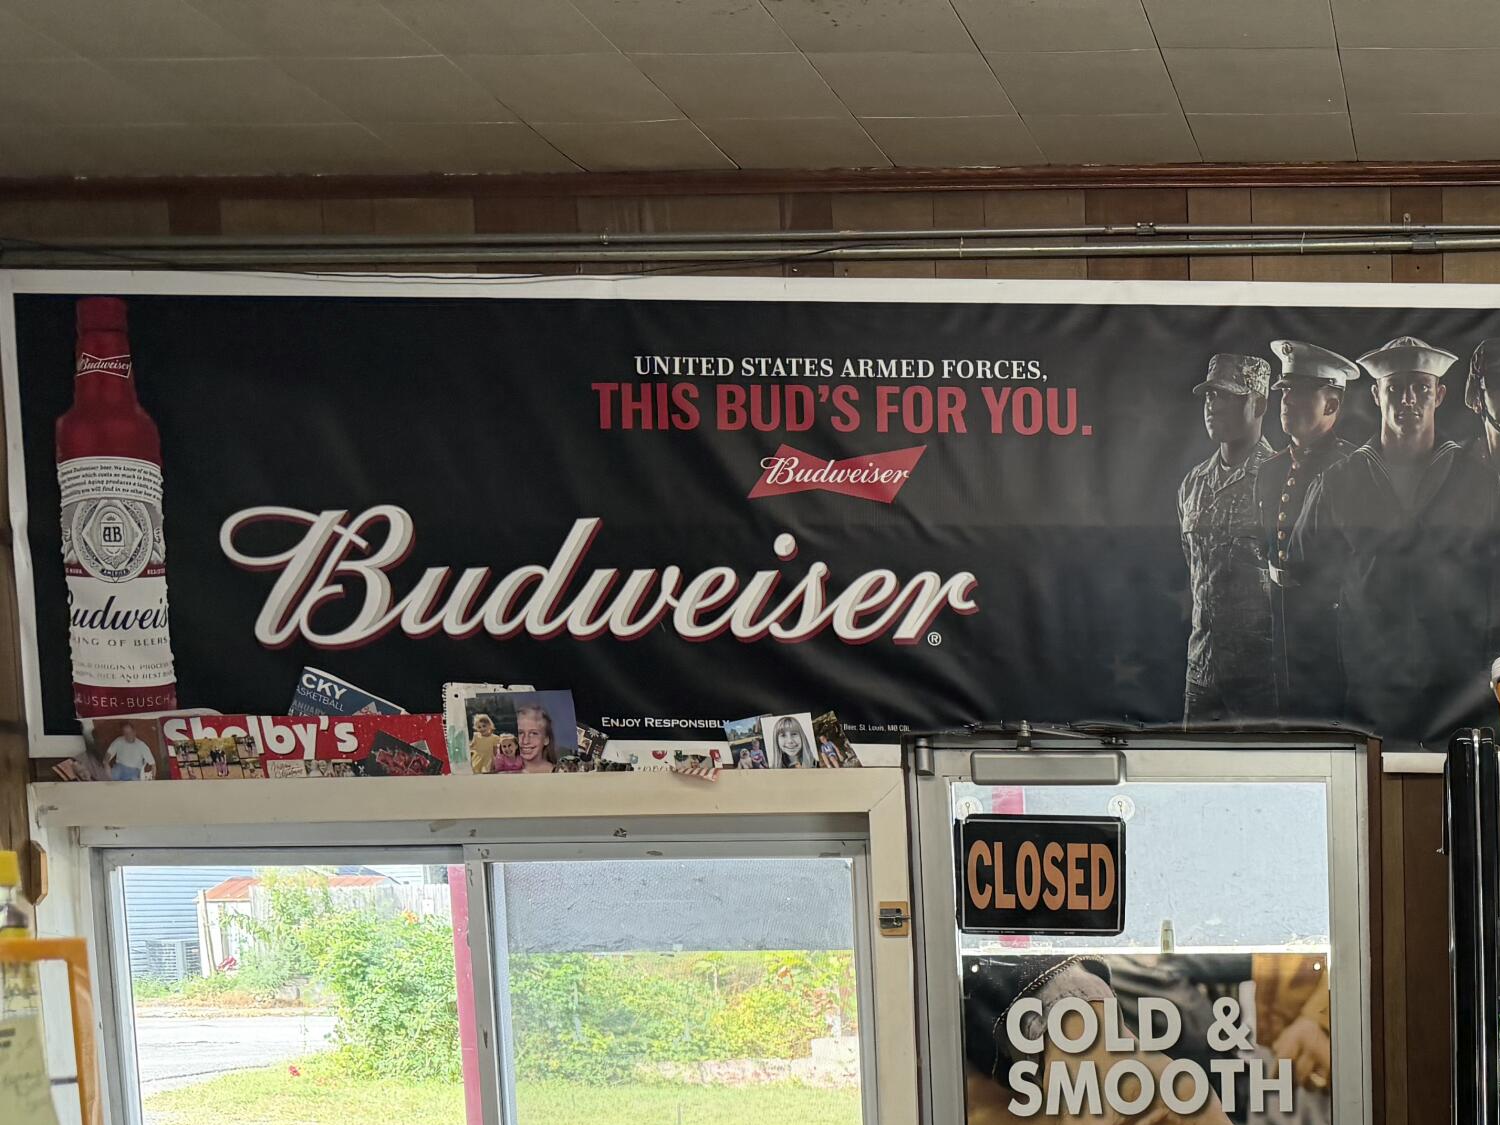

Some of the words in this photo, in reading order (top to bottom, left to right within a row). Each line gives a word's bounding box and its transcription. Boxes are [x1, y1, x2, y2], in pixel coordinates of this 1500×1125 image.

[81, 357, 131, 370] Budweiser
[634, 356, 734, 376] UNITED
[741, 357, 834, 377] STATES
[840, 359, 934, 379] ARMED
[941, 360, 1049, 383] FORCES,
[591, 382, 701, 432] THIS
[716, 383, 861, 434] BUD'S
[876, 385, 968, 434] FOR
[981, 387, 1094, 436] YOU.
[760, 455, 911, 485] Budweiser
[219, 505, 980, 650] Budweiser
[67, 590, 168, 630] udweis
[73, 637, 99, 646] ING
[134, 637, 168, 647] BEERS
[601, 716, 641, 727] ENJOY
[967, 839, 1117, 912] CLOSED
[1006, 997, 1182, 1054] COLD
[1206, 996, 1256, 1051] &
[1007, 1058, 1294, 1118] SMOOTH
